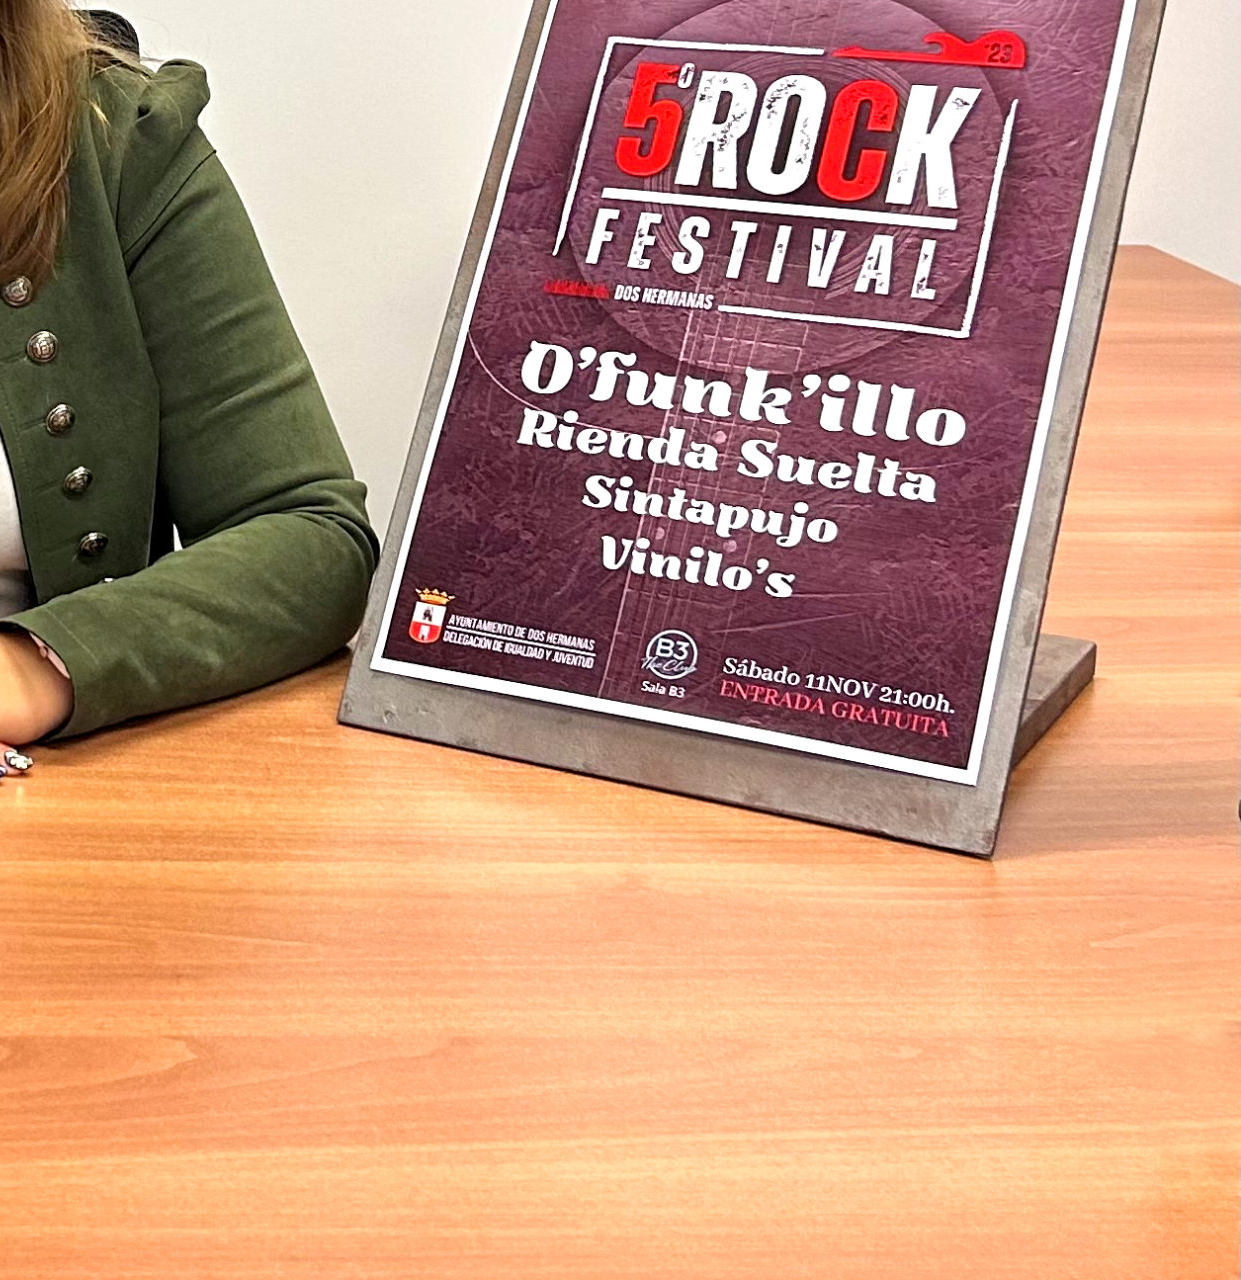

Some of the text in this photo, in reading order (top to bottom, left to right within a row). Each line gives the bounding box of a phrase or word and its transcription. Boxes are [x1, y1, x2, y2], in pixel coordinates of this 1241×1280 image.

[674, 69, 982, 209] ROCK
[585, 208, 939, 300] FESTIVAL
[614, 284, 641, 302] DOS
[641, 287, 714, 310] HERMANAS
[520, 340, 967, 447] O'funk'illo
[517, 407, 937, 504] Rienda Suelta
[581, 474, 839, 548] Sintapujo
[600, 534, 796, 599] Vinilo's
[448, 614, 595, 651] AYUNTAMIENTO DE DOS HERMANAS
[492, 639, 504, 653] DE
[503, 641, 544, 660] IGUALDAD
[545, 649, 552, 661] Y
[552, 651, 595, 669] JUVENTUD
[656, 637, 690, 661] B3
[640, 680, 686, 698] Sala B3
[719, 679, 949, 738] ENTRADA GRATUITA
[722, 657, 955, 714] Sábado 11NOV 21:00h.
